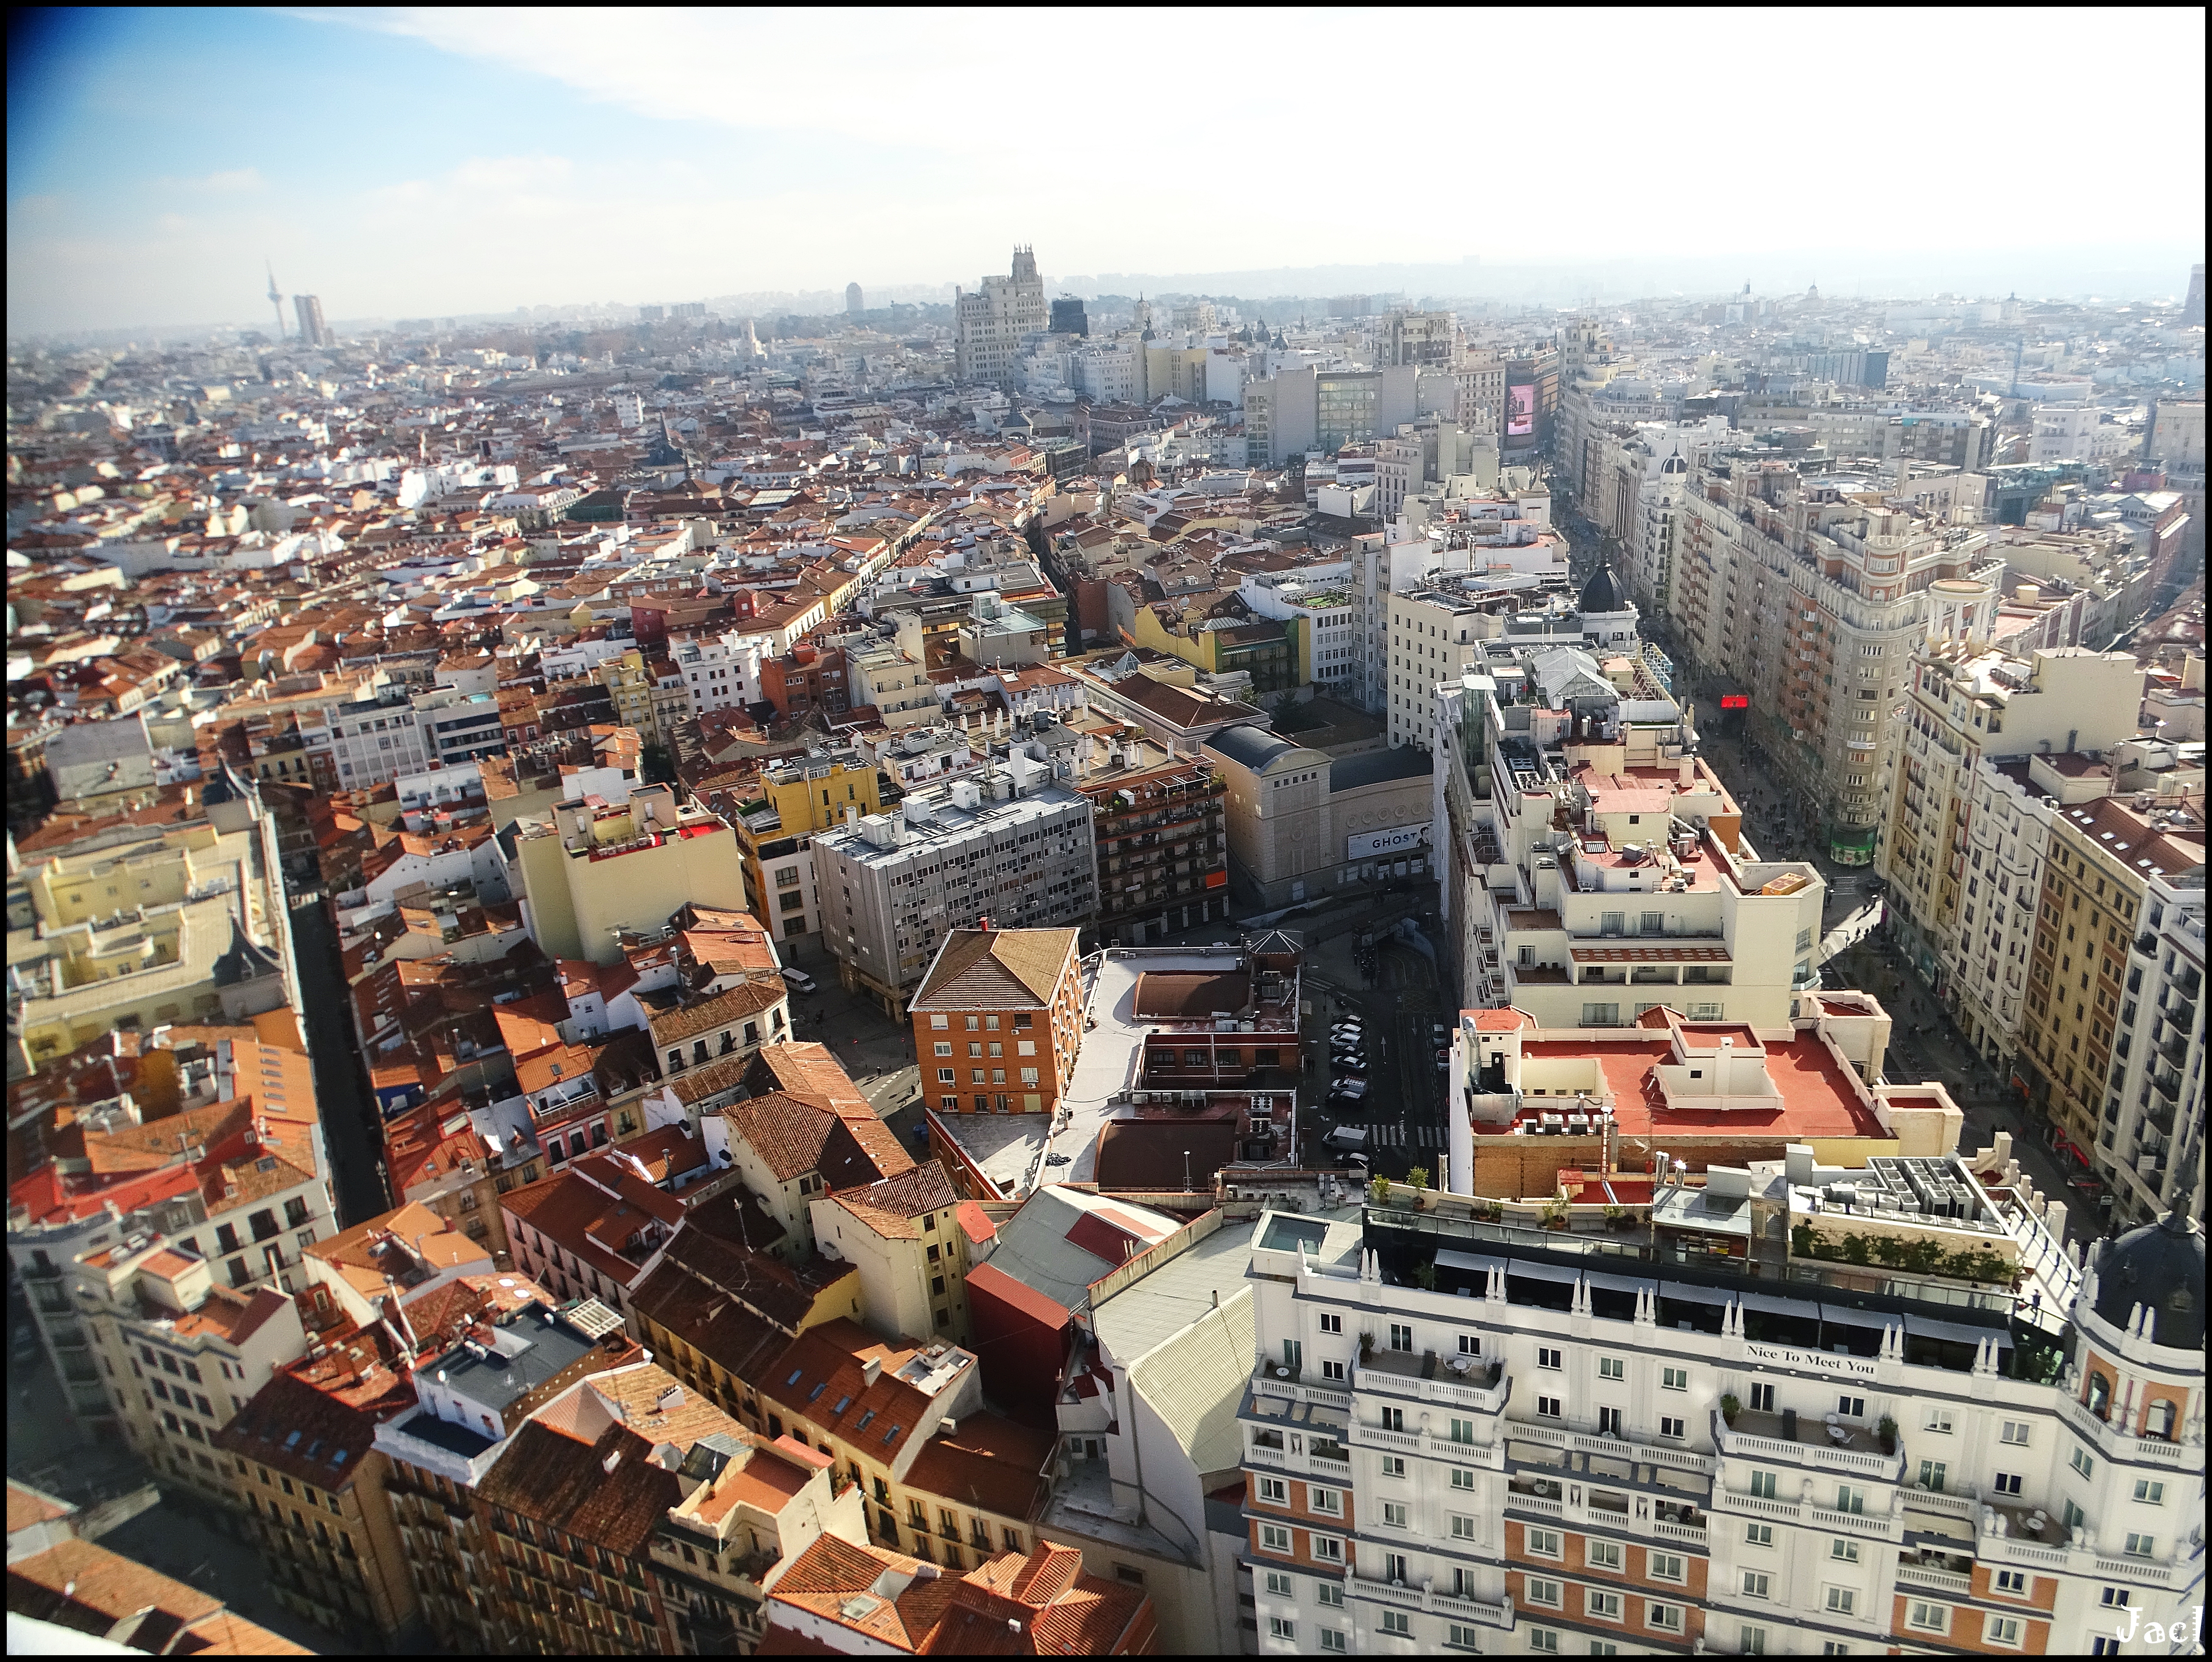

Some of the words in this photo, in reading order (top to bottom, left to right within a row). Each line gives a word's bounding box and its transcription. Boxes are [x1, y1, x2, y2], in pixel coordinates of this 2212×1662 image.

[1372, 832, 1417, 848] GHOST
[1747, 1345, 1778, 1359] Nice
[1782, 1351, 1800, 1362] To
[1805, 1355, 1841, 1369] Meet
[1847, 1361, 1874, 1374] You
